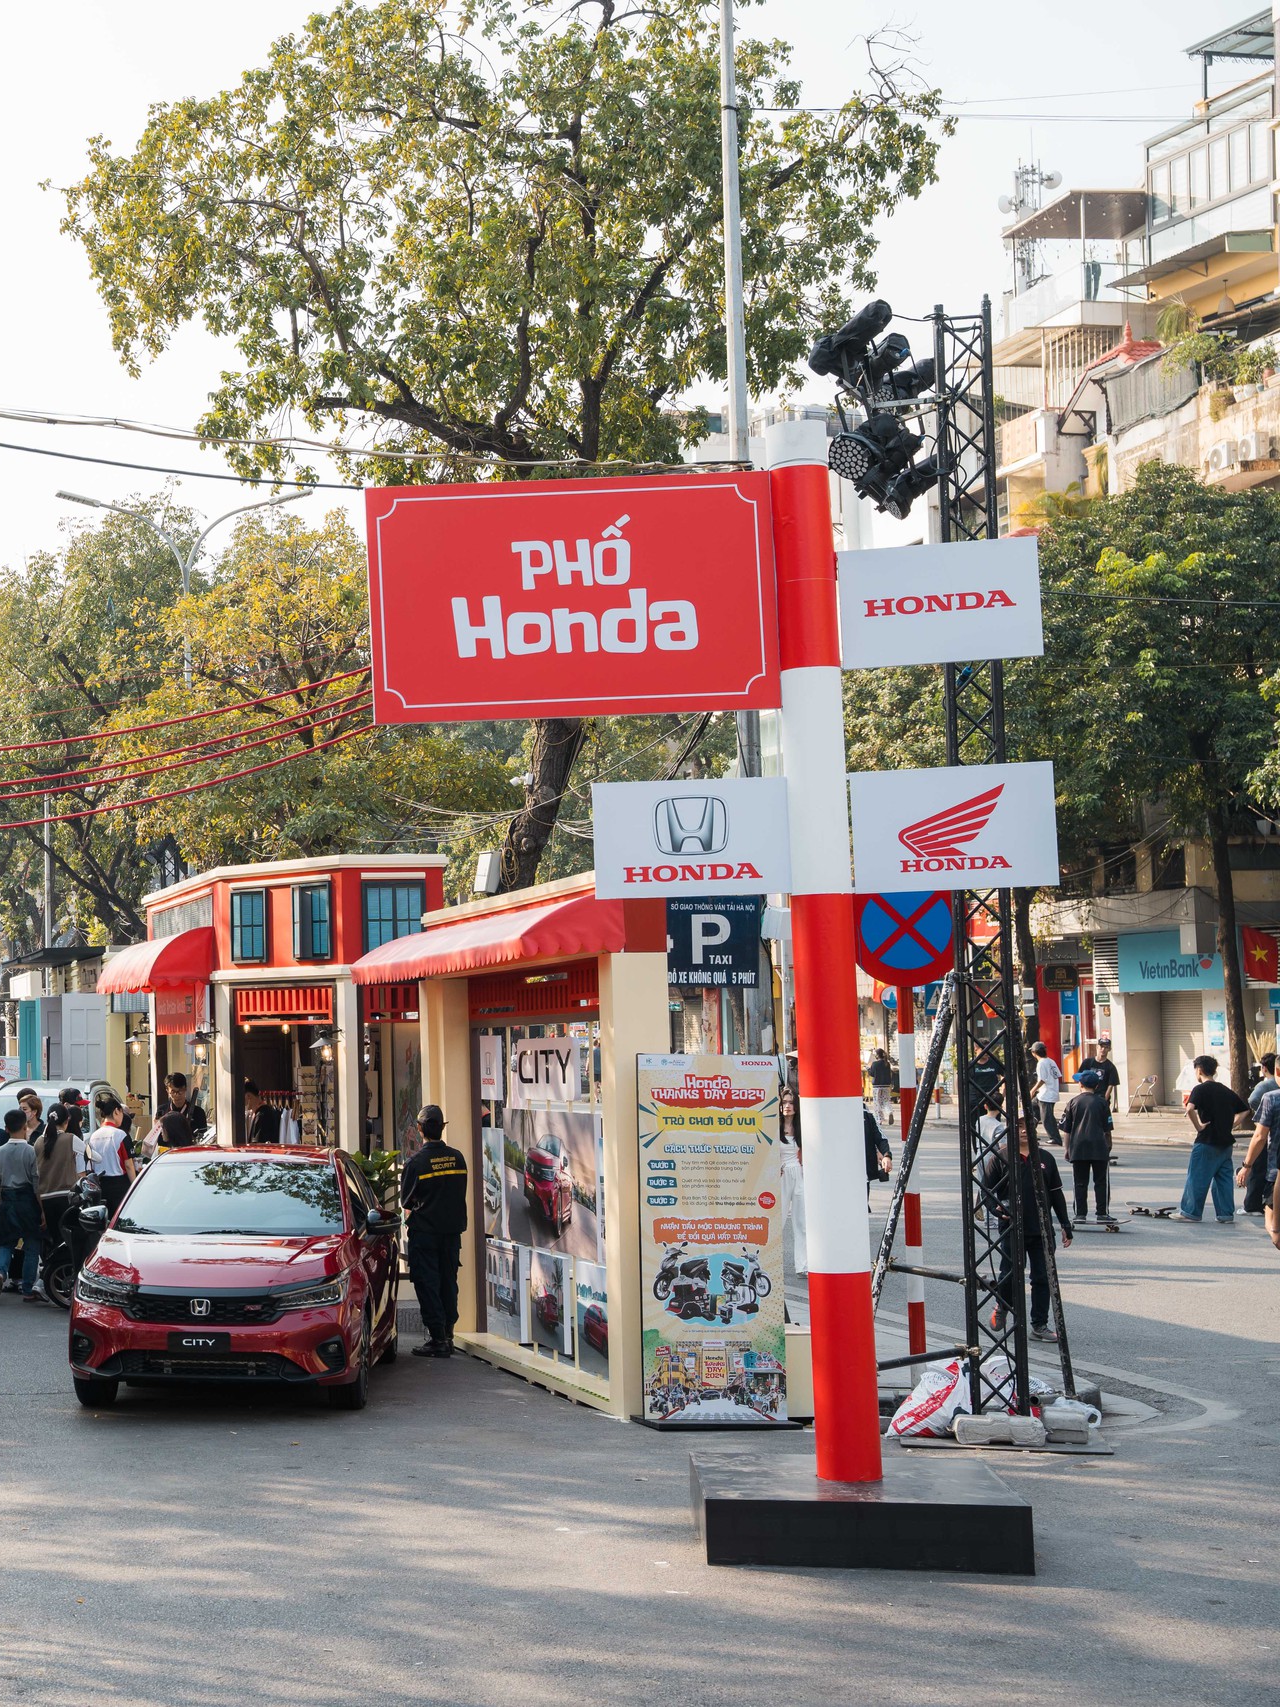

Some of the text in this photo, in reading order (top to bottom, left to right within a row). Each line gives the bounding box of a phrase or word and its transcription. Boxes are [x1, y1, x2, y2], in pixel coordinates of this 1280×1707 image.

[511, 514, 631, 590] PHỐ
[863, 589, 1017, 618] HONDA
[451, 588, 700, 659] Honda
[900, 855, 1013, 873] HONDA
[623, 862, 763, 883] HONDA
[670, 901, 679, 910] SỞ
[679, 903, 694, 911] GIAO
[694, 902, 713, 911] THÔNG
[726, 901, 736, 911] TẢI
[736, 902, 744, 911] HÀ
[745, 903, 755, 913] NỘI
[691, 913, 731, 964] P
[708, 955, 732, 965] TAXI
[678, 971, 687, 984] XE
[688, 969, 712, 984] KHÔNG
[713, 969, 727, 985] QUÁ
[732, 972, 737, 984] 5
[738, 969, 756, 984] PHÚT
[1139, 958, 1200, 980] VietinBank
[518, 1048, 572, 1085] CITY
[686, 1076, 732, 1089] Honda
[651, 1088, 765, 1100] THANKS DAY 2024
[662, 1113, 756, 1126] TRÒ CHƠI ĐỐ VUI
[663, 1143, 686, 1154] CÁCH
[714, 1145, 739, 1154] THAM
[741, 1145, 755, 1154] GIA
[432, 1161, 456, 1170] SECURITY
[182, 1338, 216, 1346] CITY
